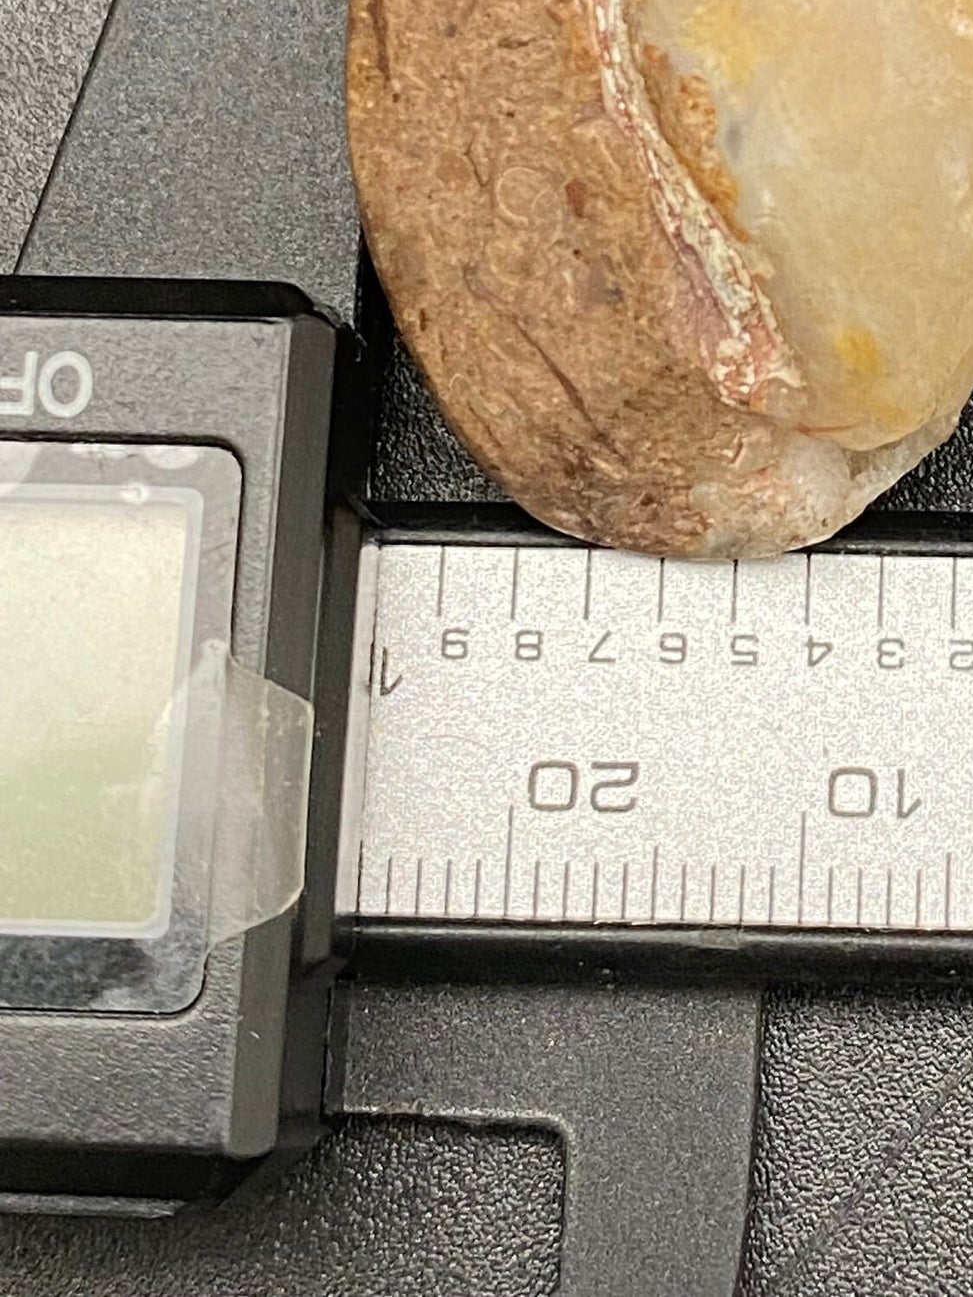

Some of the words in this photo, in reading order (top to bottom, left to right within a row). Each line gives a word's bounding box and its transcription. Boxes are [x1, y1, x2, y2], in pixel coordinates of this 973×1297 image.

[440, 627, 470, 660] 9
[513, 629, 544, 662] 8
[587, 630, 617, 664] 7
[658, 631, 688, 665] 6
[730, 633, 760, 667] 5
[804, 634, 833, 668] 4
[876, 637, 906, 670] 3
[527, 760, 640, 813] 20
[828, 766, 922, 819] 10
